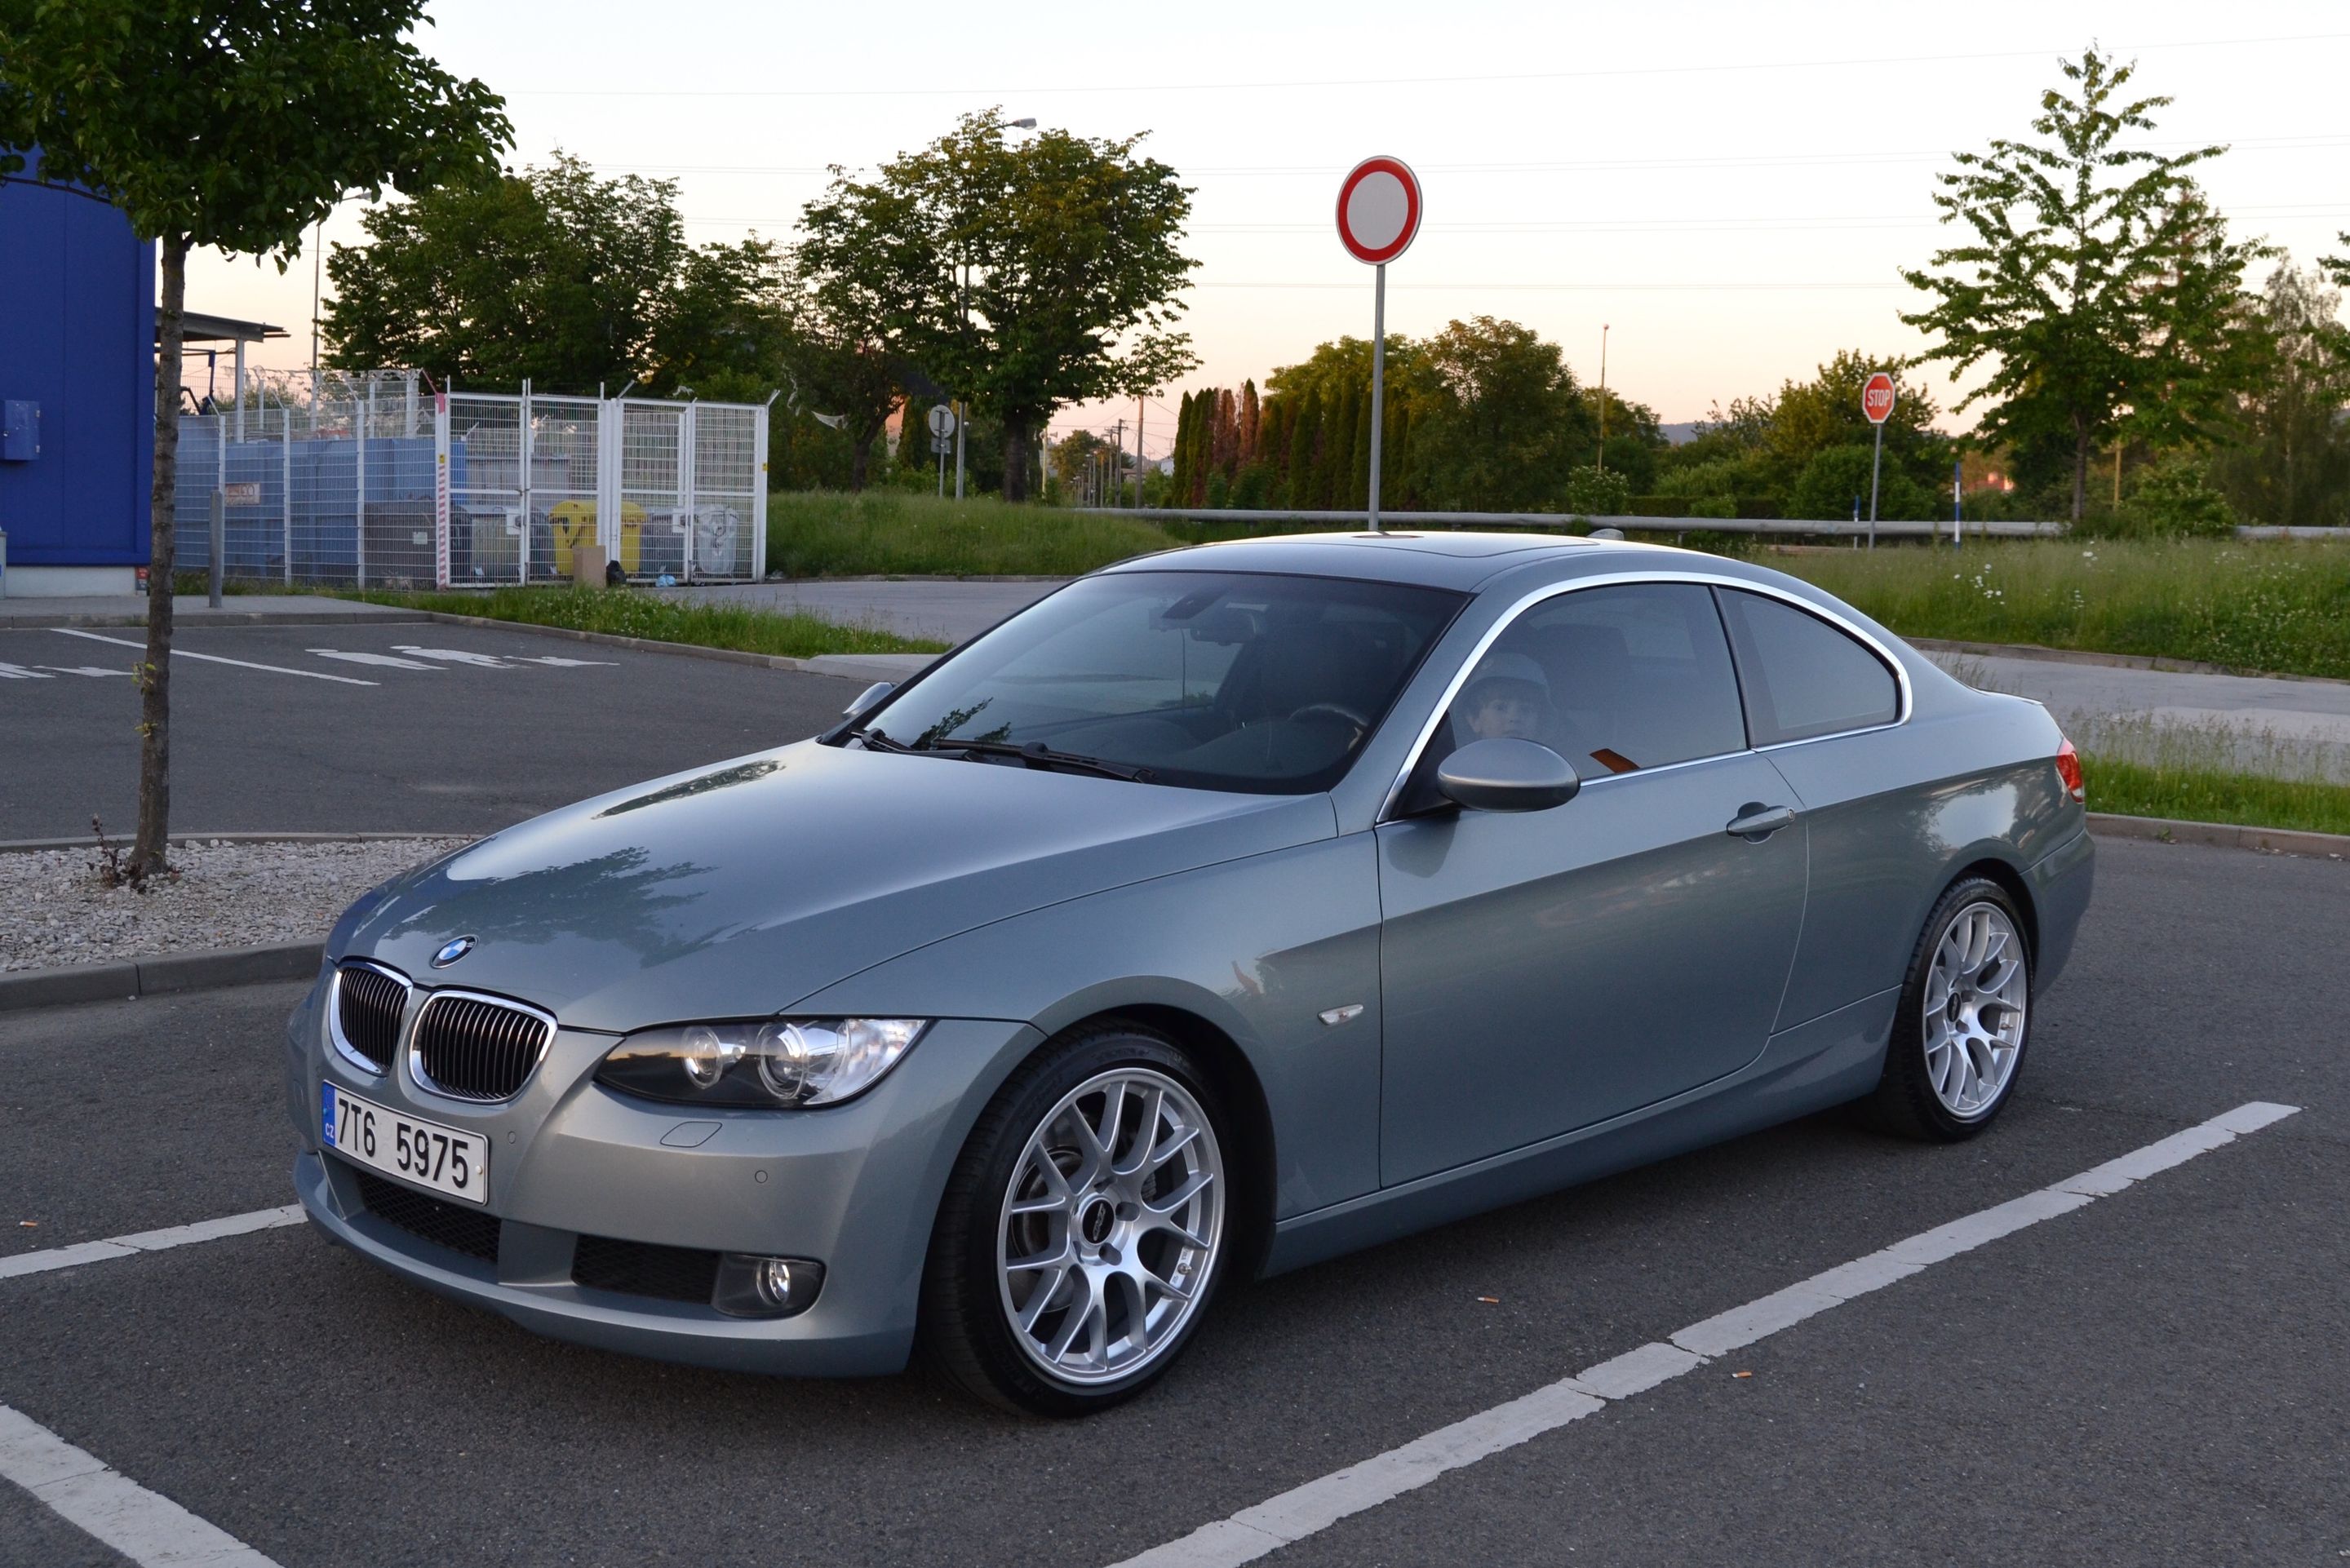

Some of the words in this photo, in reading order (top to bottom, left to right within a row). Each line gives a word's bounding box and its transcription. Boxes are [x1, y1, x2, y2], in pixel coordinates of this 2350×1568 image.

[1867, 389, 1891, 407] STOP
[326, 1123, 335, 1139] CZ
[339, 1097, 376, 1158] 7T6
[397, 1122, 468, 1189] 5975
